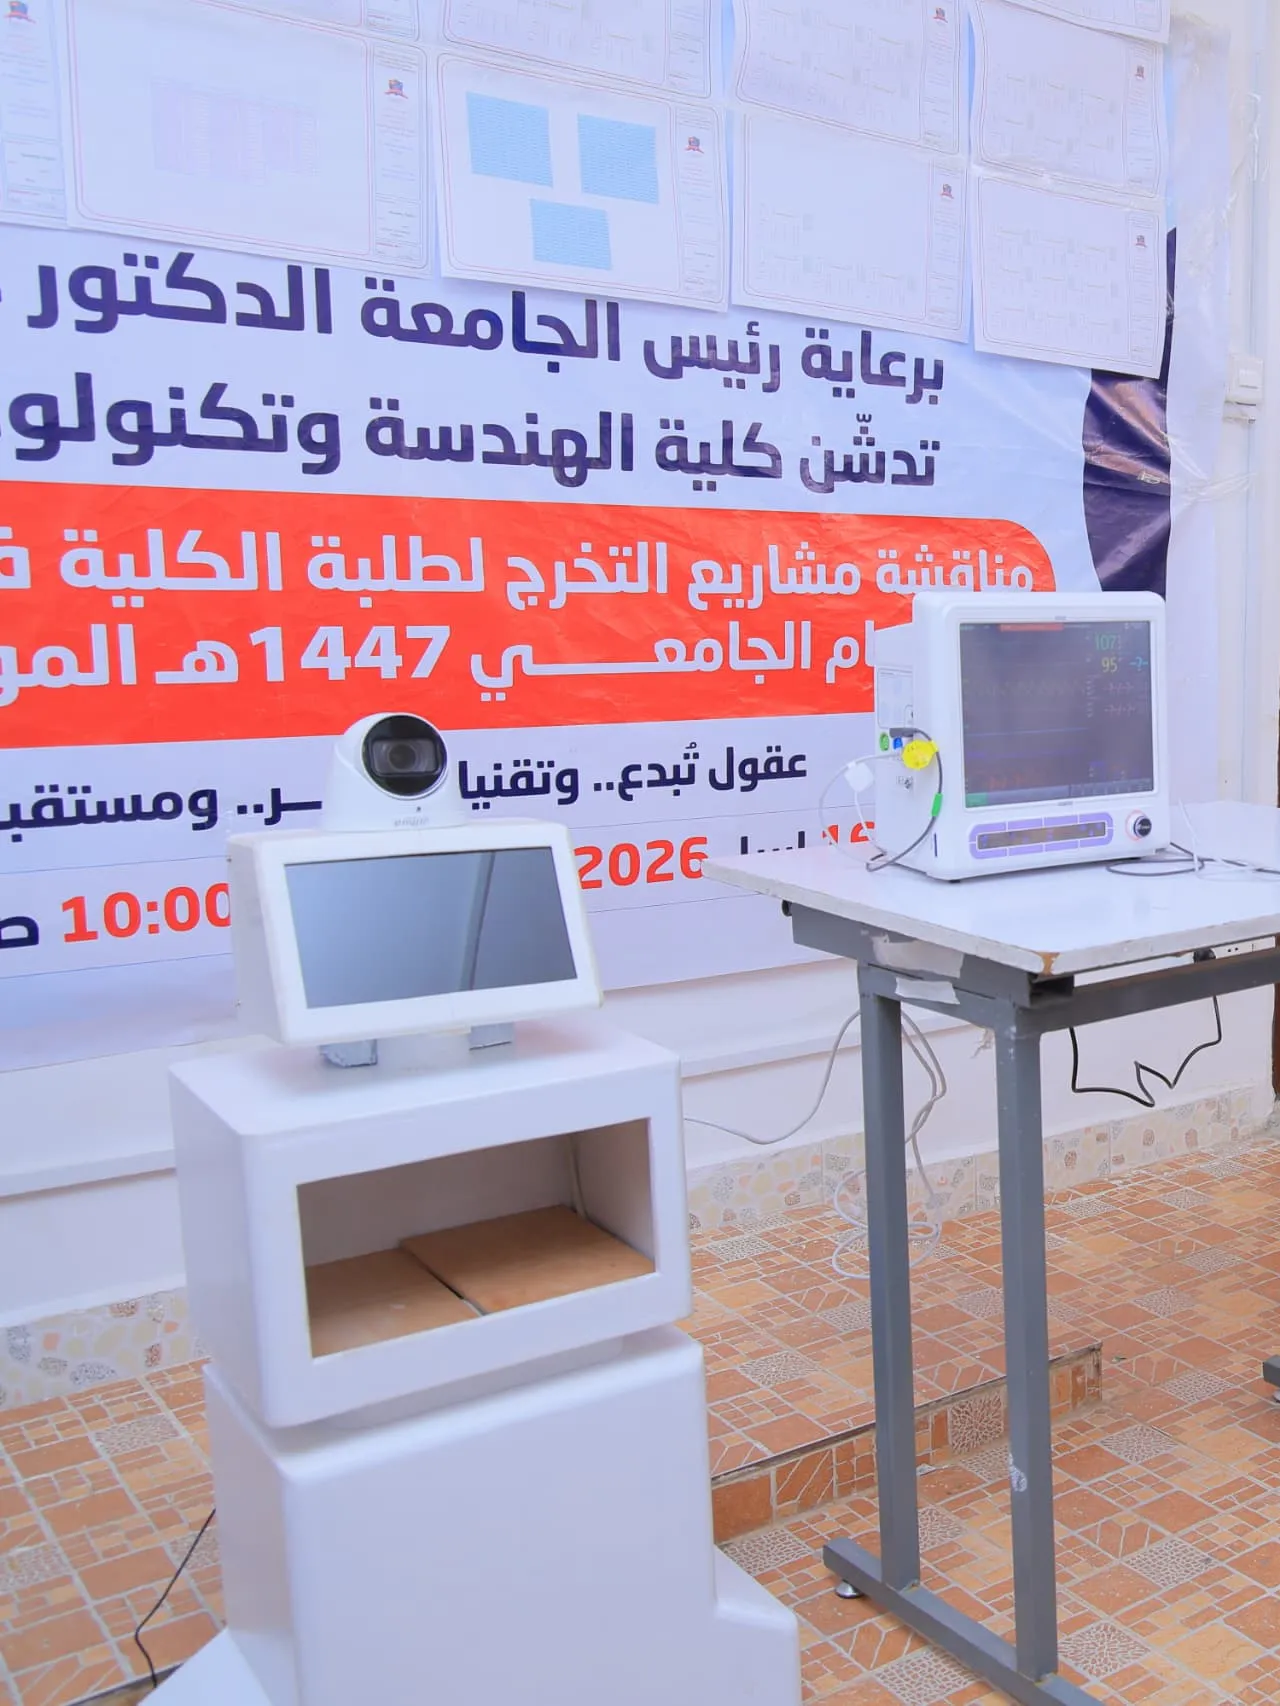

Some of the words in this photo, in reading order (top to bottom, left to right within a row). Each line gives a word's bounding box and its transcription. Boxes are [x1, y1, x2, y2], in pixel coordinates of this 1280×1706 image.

[27, 251, 333, 335] الدكتور
[360, 277, 621, 374] الجامعة
[643, 320, 781, 394] رئيس
[801, 327, 944, 405] برعاية
[0, 372, 341, 476] وتكنولو
[365, 396, 634, 488] الهندسة
[655, 418, 783, 492] كلية
[60, 528, 283, 608] الكلية
[307, 534, 485, 608] لطلبة
[506, 541, 668, 611] التخرج
[687, 541, 862, 611] مشاريع
[876, 544, 1034, 594] مناقشة
[458, 758, 580, 811] وتقنيا
[708, 744, 807, 793] عقول
[0, 784, 219, 843] ومستقب
[574, 836, 708, 889] 2026
[61, 882, 231, 943] 10:00
